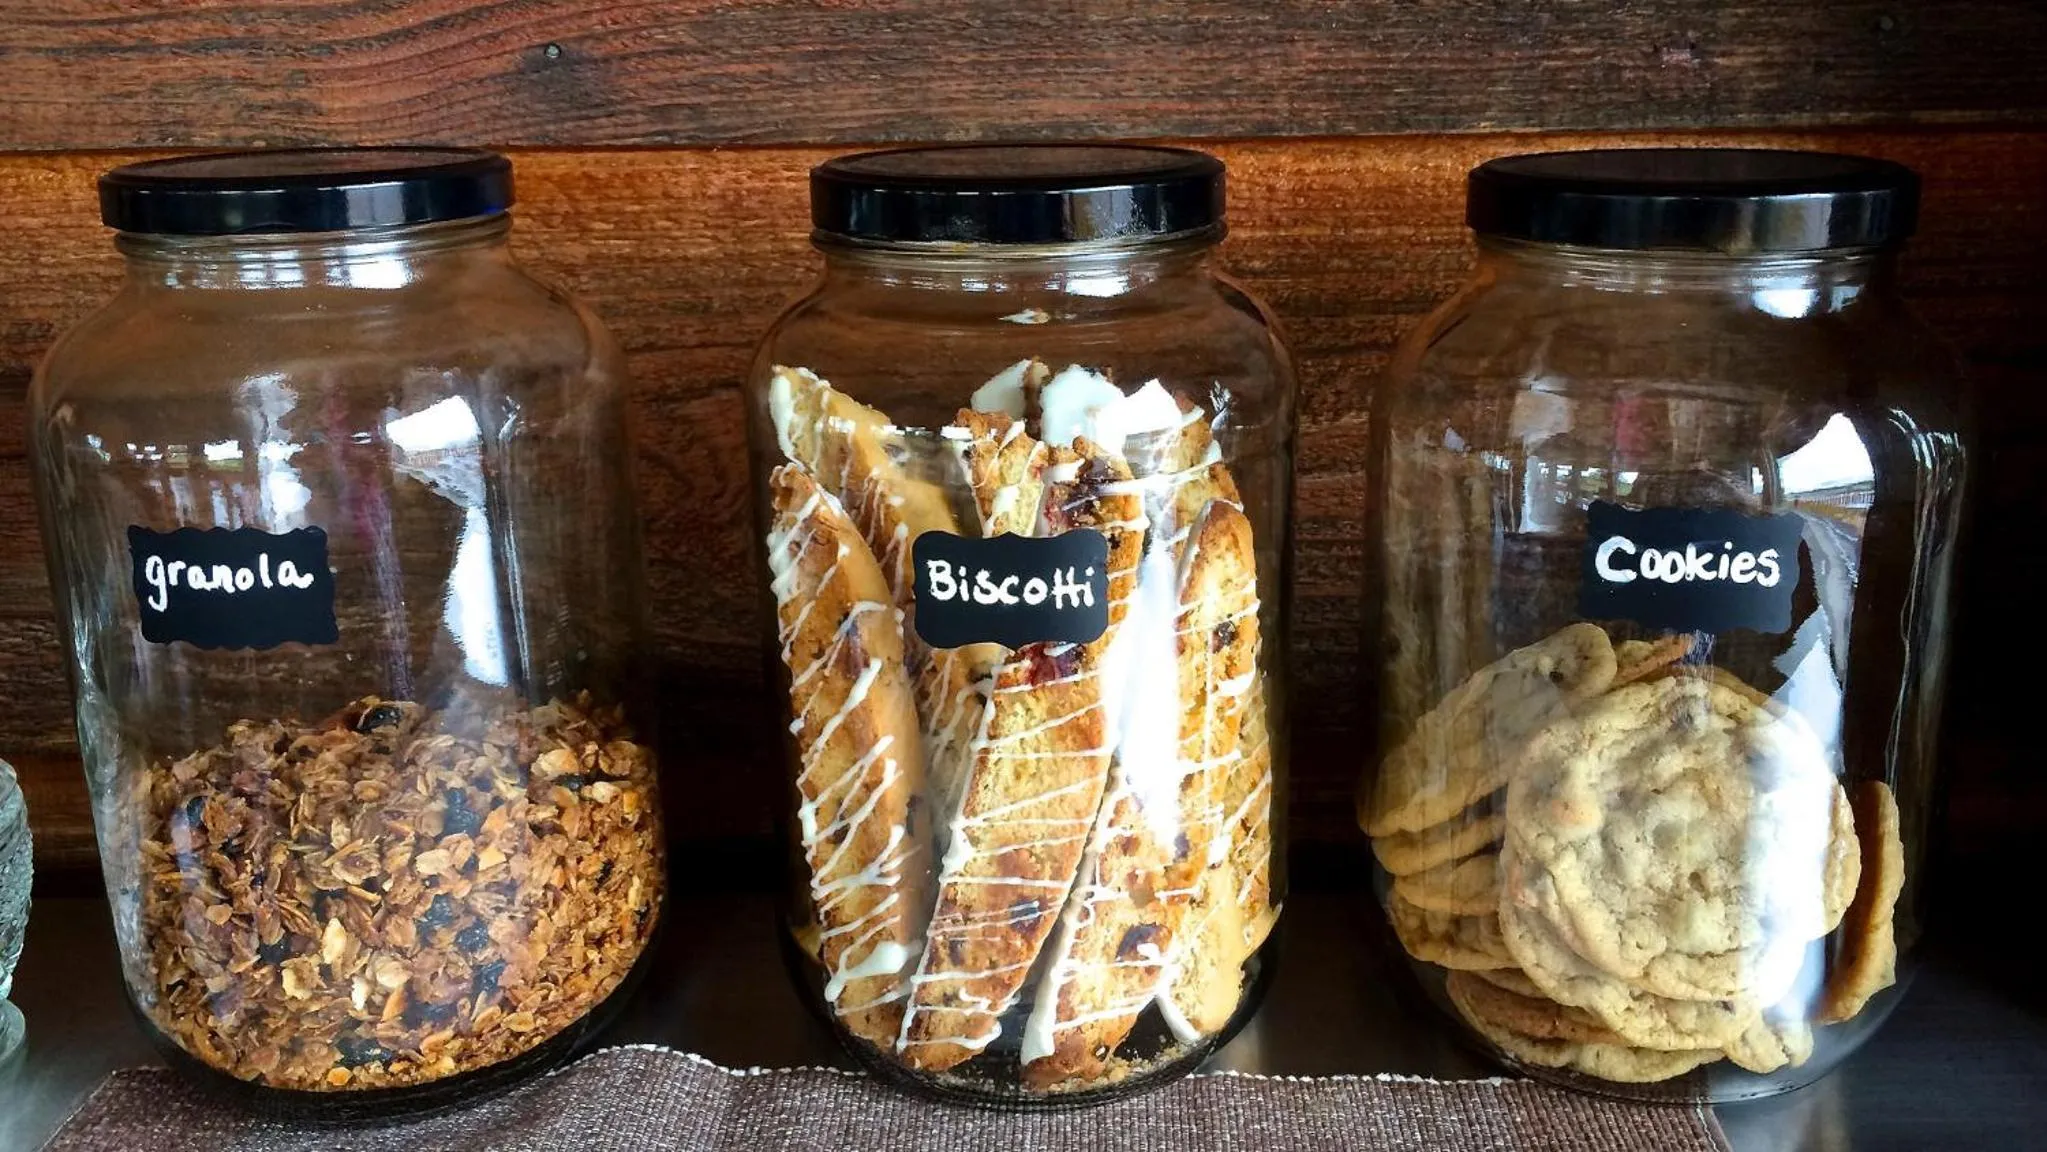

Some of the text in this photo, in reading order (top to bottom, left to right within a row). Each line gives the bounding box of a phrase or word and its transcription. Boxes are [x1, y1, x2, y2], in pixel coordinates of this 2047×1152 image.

[145, 553, 315, 613] granola
[926, 559, 1096, 610] Biscotti
[1594, 535, 1782, 588] Cookies
